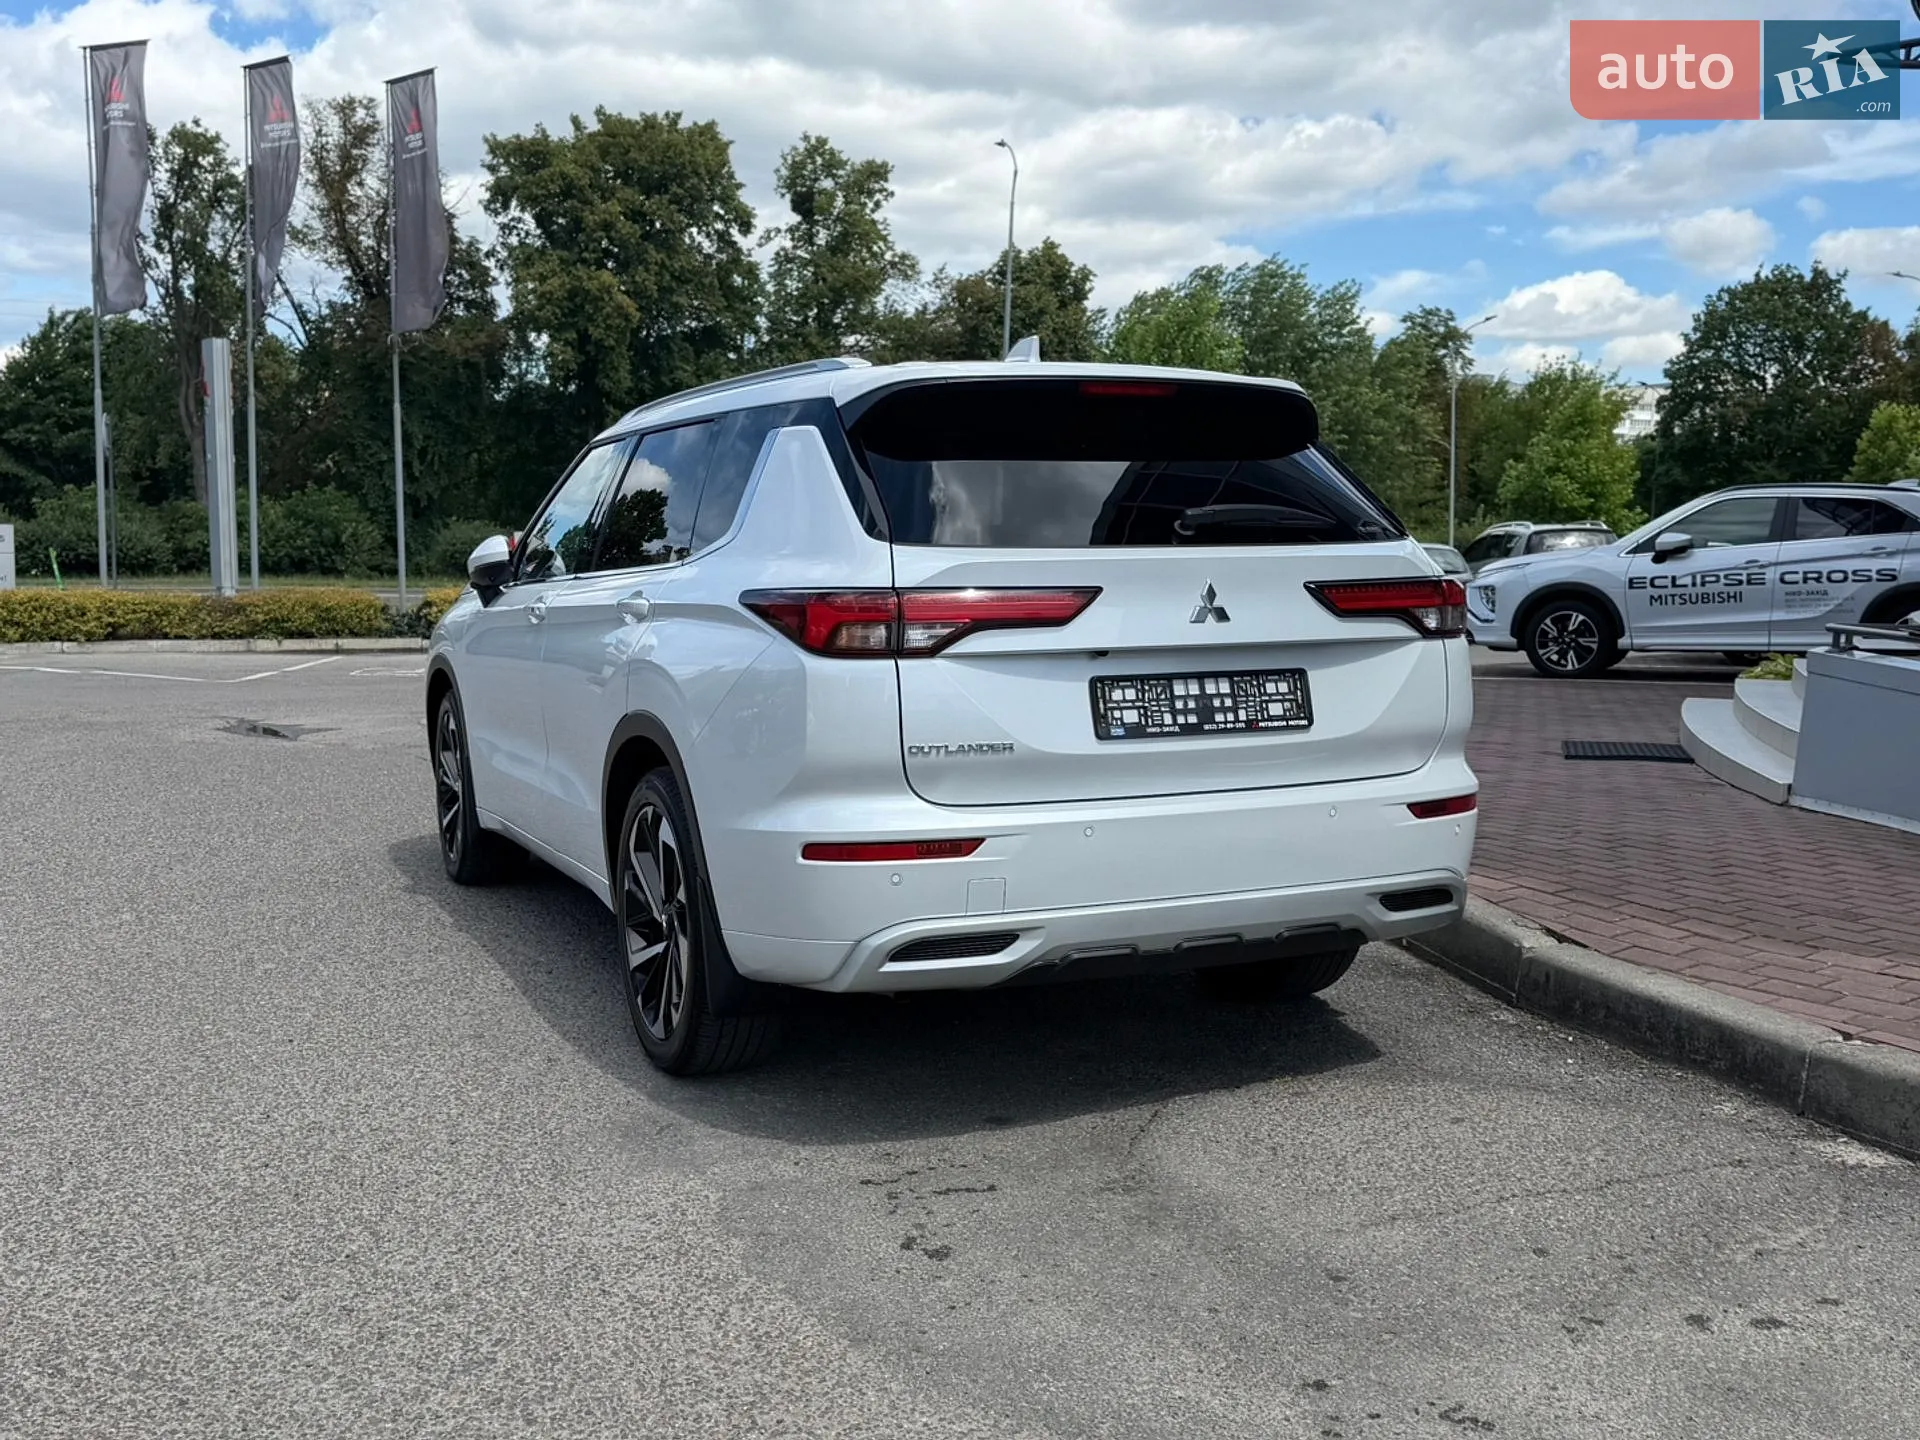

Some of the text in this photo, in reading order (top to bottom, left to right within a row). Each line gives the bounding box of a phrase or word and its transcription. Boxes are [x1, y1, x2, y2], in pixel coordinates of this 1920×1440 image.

[1627, 568, 1898, 590] ECLIPSE CROSS
[1649, 591, 1743, 606] MITSUBISHI
[908, 742, 1015, 756] OUTLANDER
